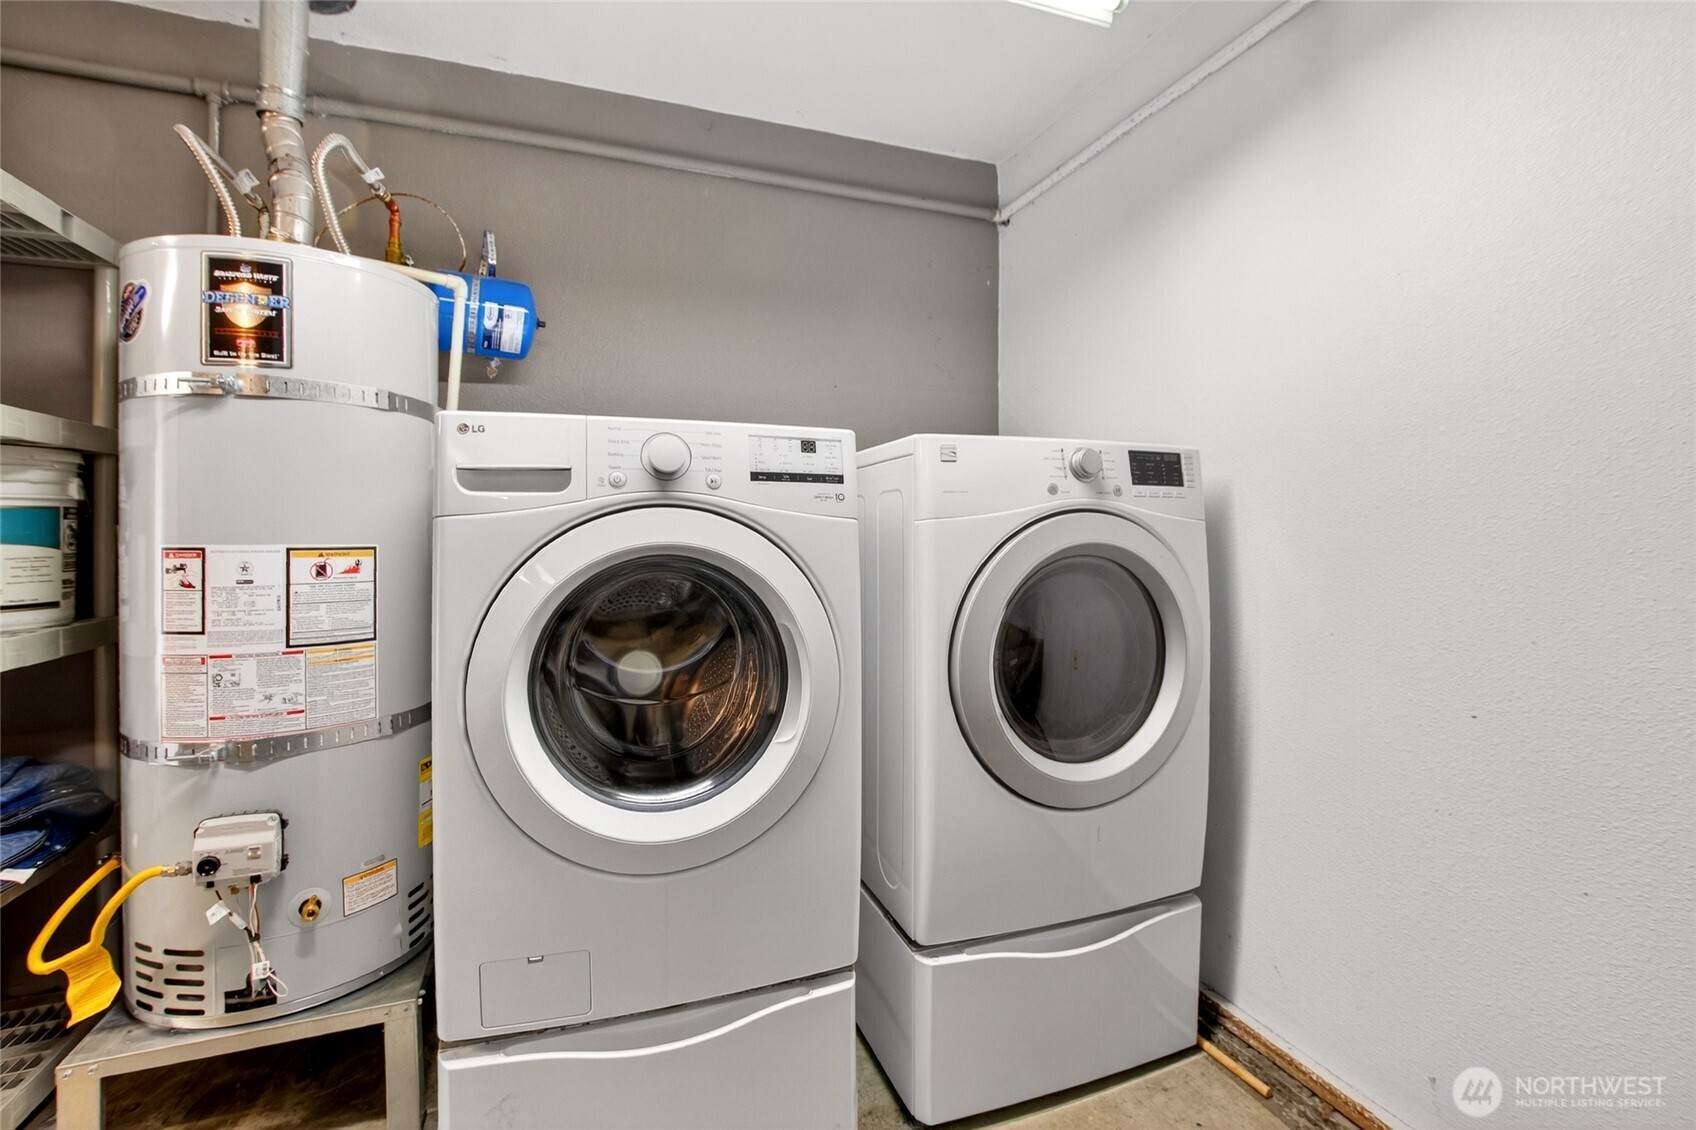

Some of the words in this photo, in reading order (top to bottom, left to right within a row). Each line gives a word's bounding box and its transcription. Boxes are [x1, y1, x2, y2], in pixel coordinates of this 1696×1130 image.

[203, 291, 291, 308] DEFENDER
[471, 425, 485, 433] LG
[835, 493, 845, 502] 10
